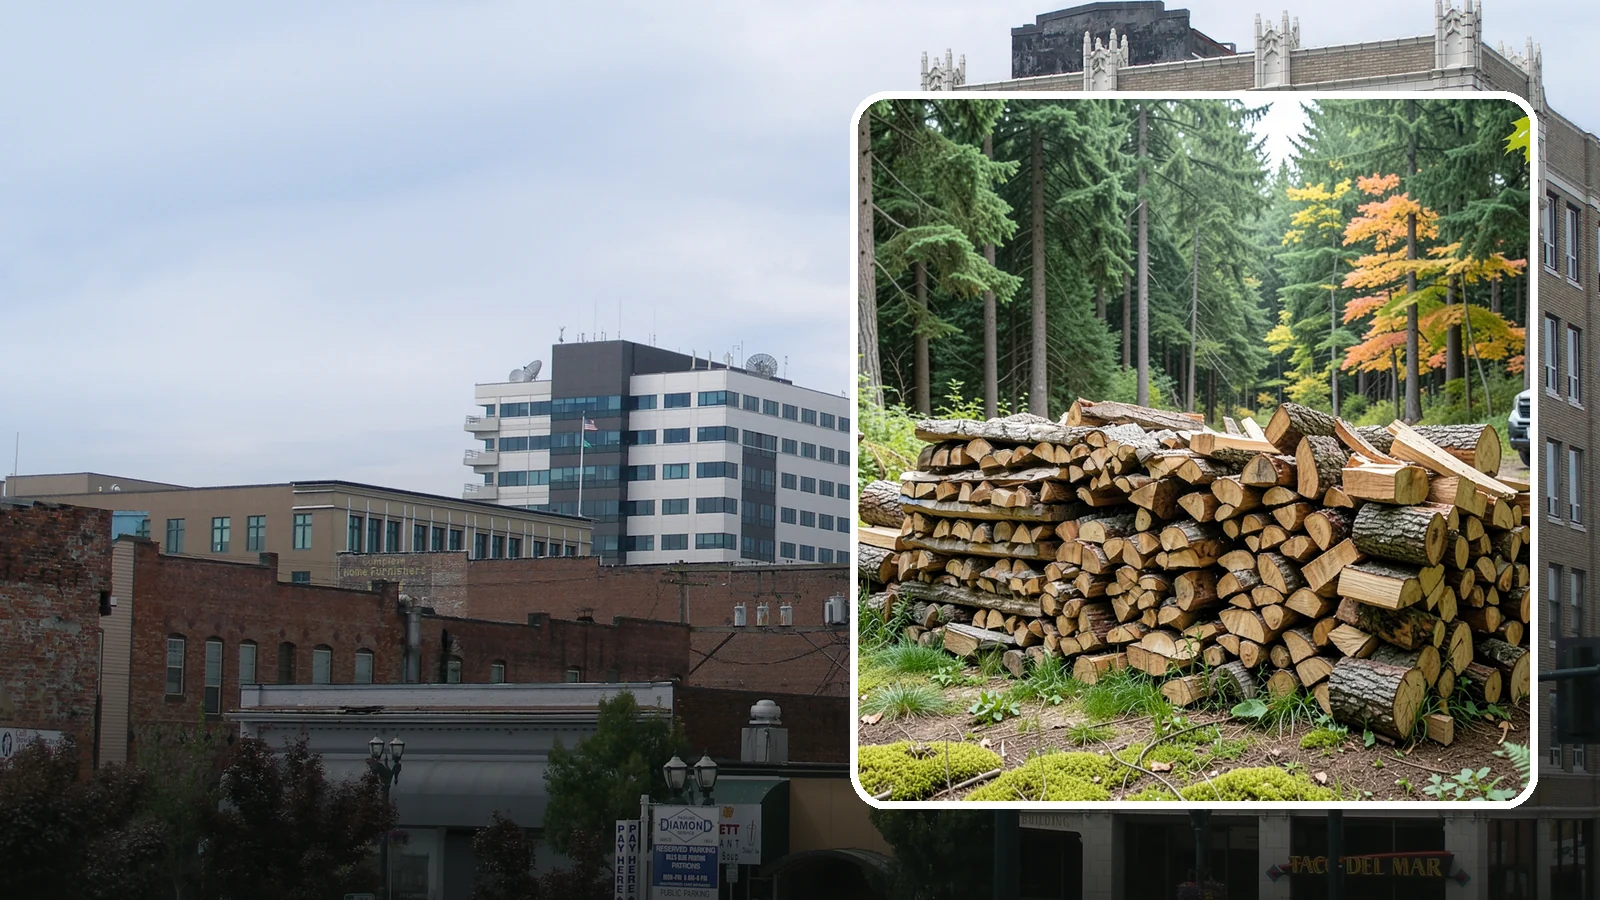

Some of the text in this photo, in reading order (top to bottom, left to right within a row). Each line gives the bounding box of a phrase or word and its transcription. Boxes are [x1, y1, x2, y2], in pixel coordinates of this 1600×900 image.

[343, 566, 426, 577] Home Furnishers
[660, 818, 713, 833] DIAMOND
[1022, 815, 1070, 827] BUILDING
[656, 845, 716, 854] RESERVED PARKING
[617, 825, 625, 893] PAY HERE
[722, 852, 739, 862] Soup
[1290, 855, 1442, 877] TAC DEL MAR
[628, 856, 636, 893] HERE
[661, 889, 710, 897] PUBLIC PARKING
